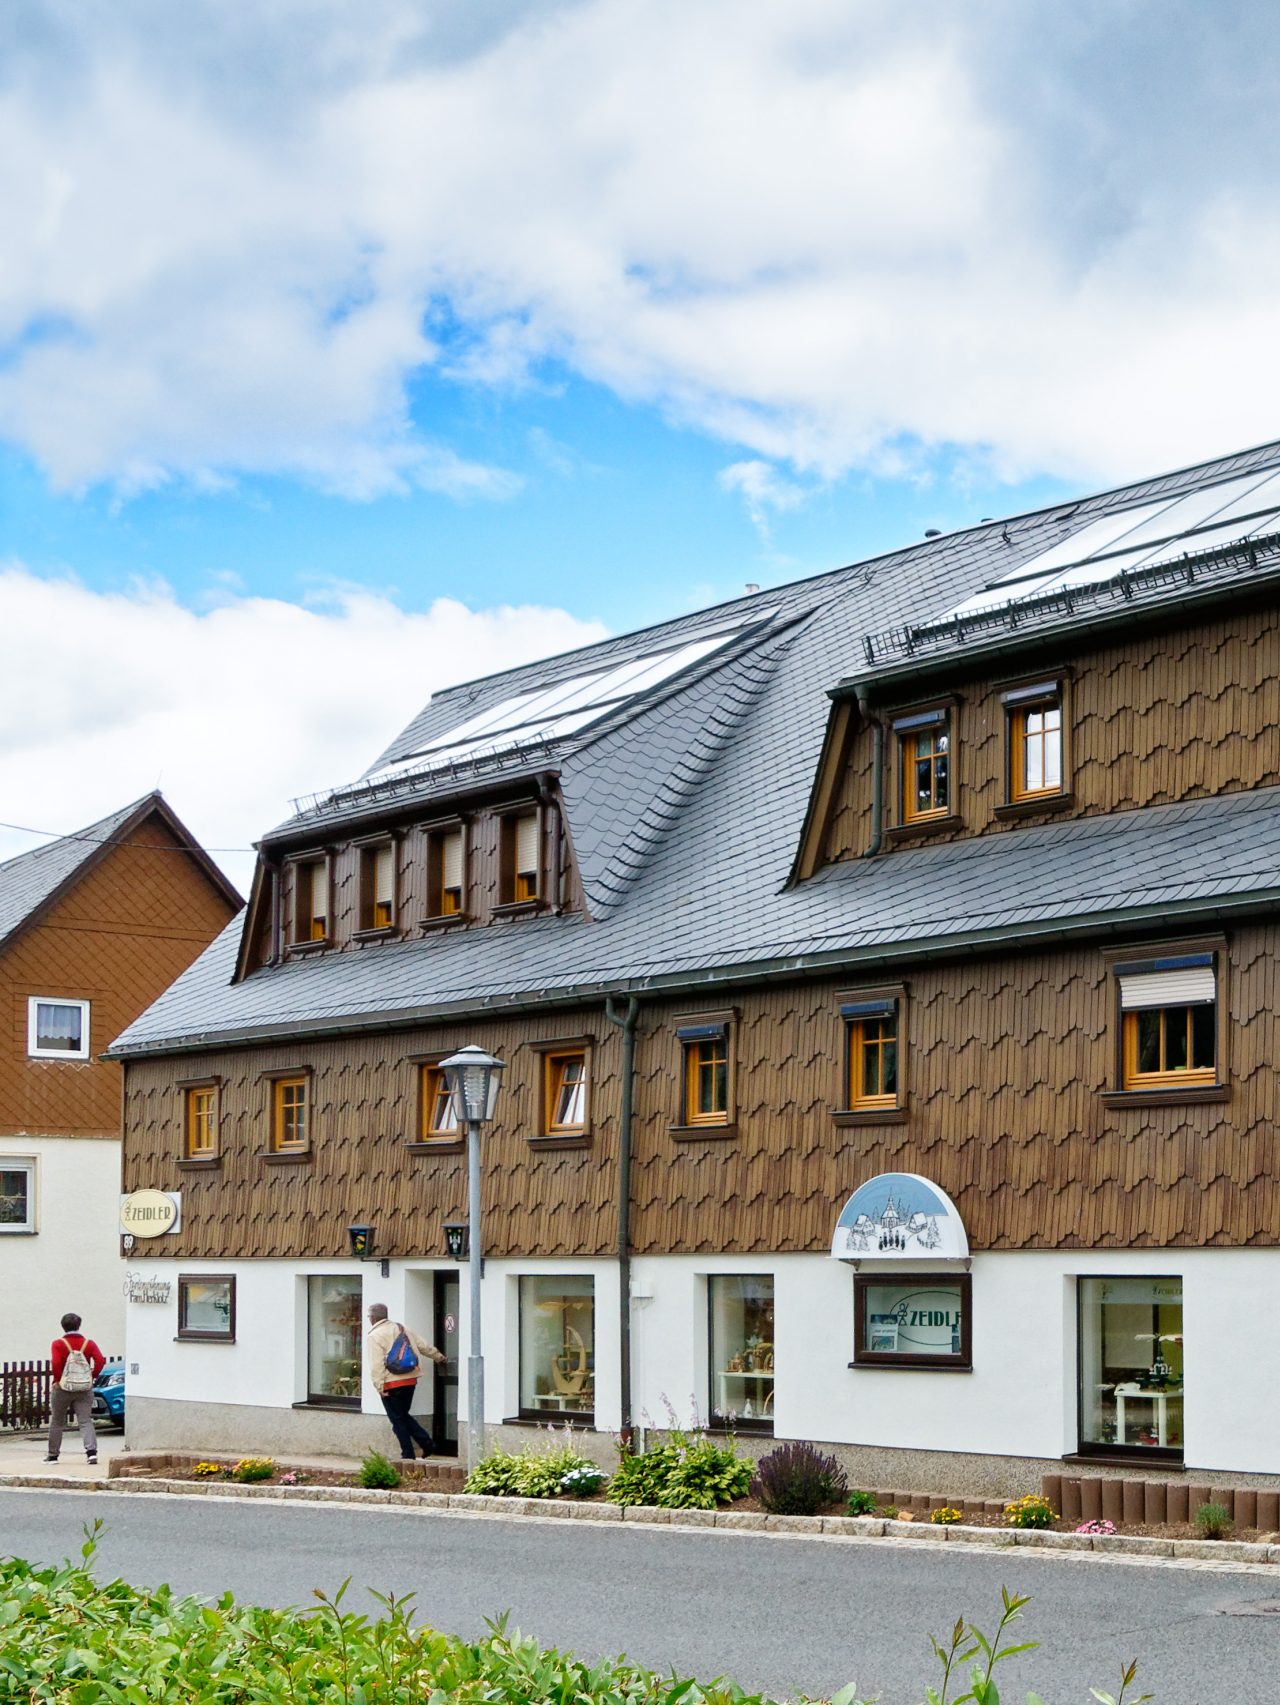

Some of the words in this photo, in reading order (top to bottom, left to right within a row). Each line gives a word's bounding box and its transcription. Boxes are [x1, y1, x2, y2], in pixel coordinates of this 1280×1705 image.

[132, 1206, 171, 1221] ZEIDLER
[124, 1235, 133, 1248] 89
[910, 1310, 961, 1327] ZEIDLE
